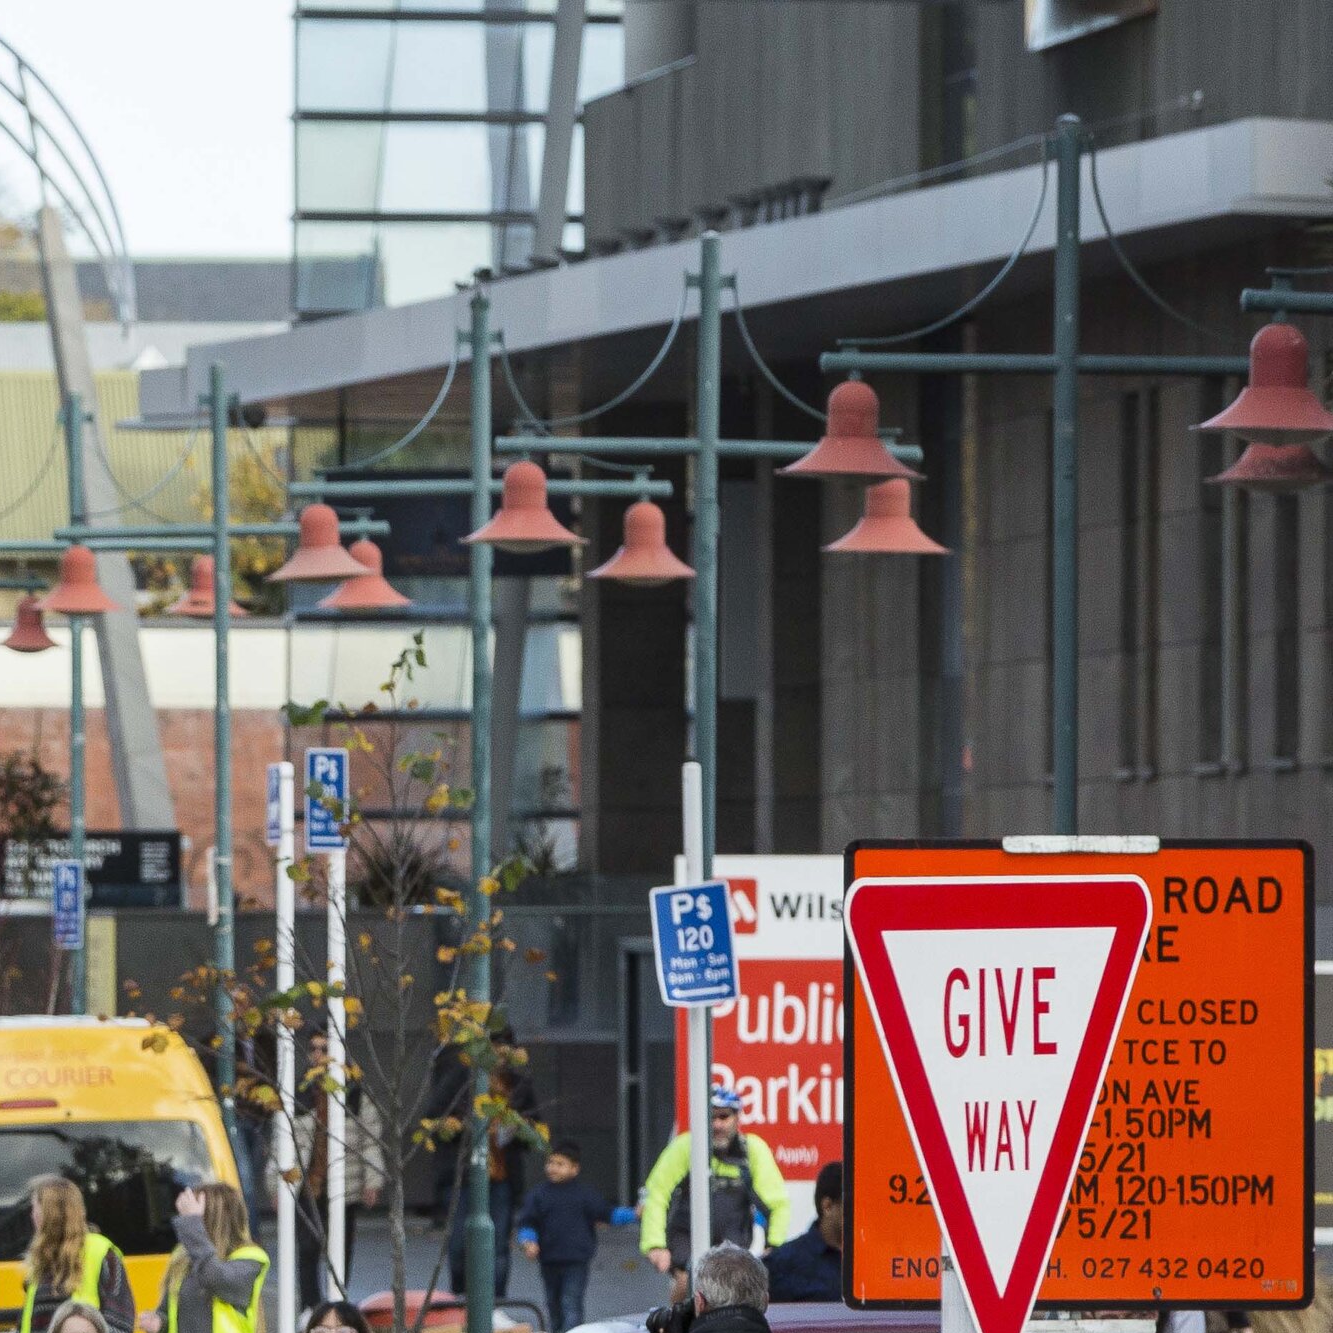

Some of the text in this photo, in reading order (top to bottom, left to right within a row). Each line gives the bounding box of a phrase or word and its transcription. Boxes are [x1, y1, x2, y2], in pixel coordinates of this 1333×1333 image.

[670, 892, 713, 925] P$
[1163, 876, 1283, 914] ROAD
[676, 924, 714, 953] 120
[943, 967, 1058, 1059] GIVE
[1137, 1000, 1259, 1025] CLOSED
[1190, 1039, 1227, 1065] TO
[4, 1064, 115, 1089] COURIER
[1141, 1079, 1201, 1105] AVE
[965, 1100, 1037, 1172] WAY
[1081, 1257, 1131, 1279] 027
[1138, 1257, 1189, 1279] 432
[1196, 1257, 1265, 1279] 0420
